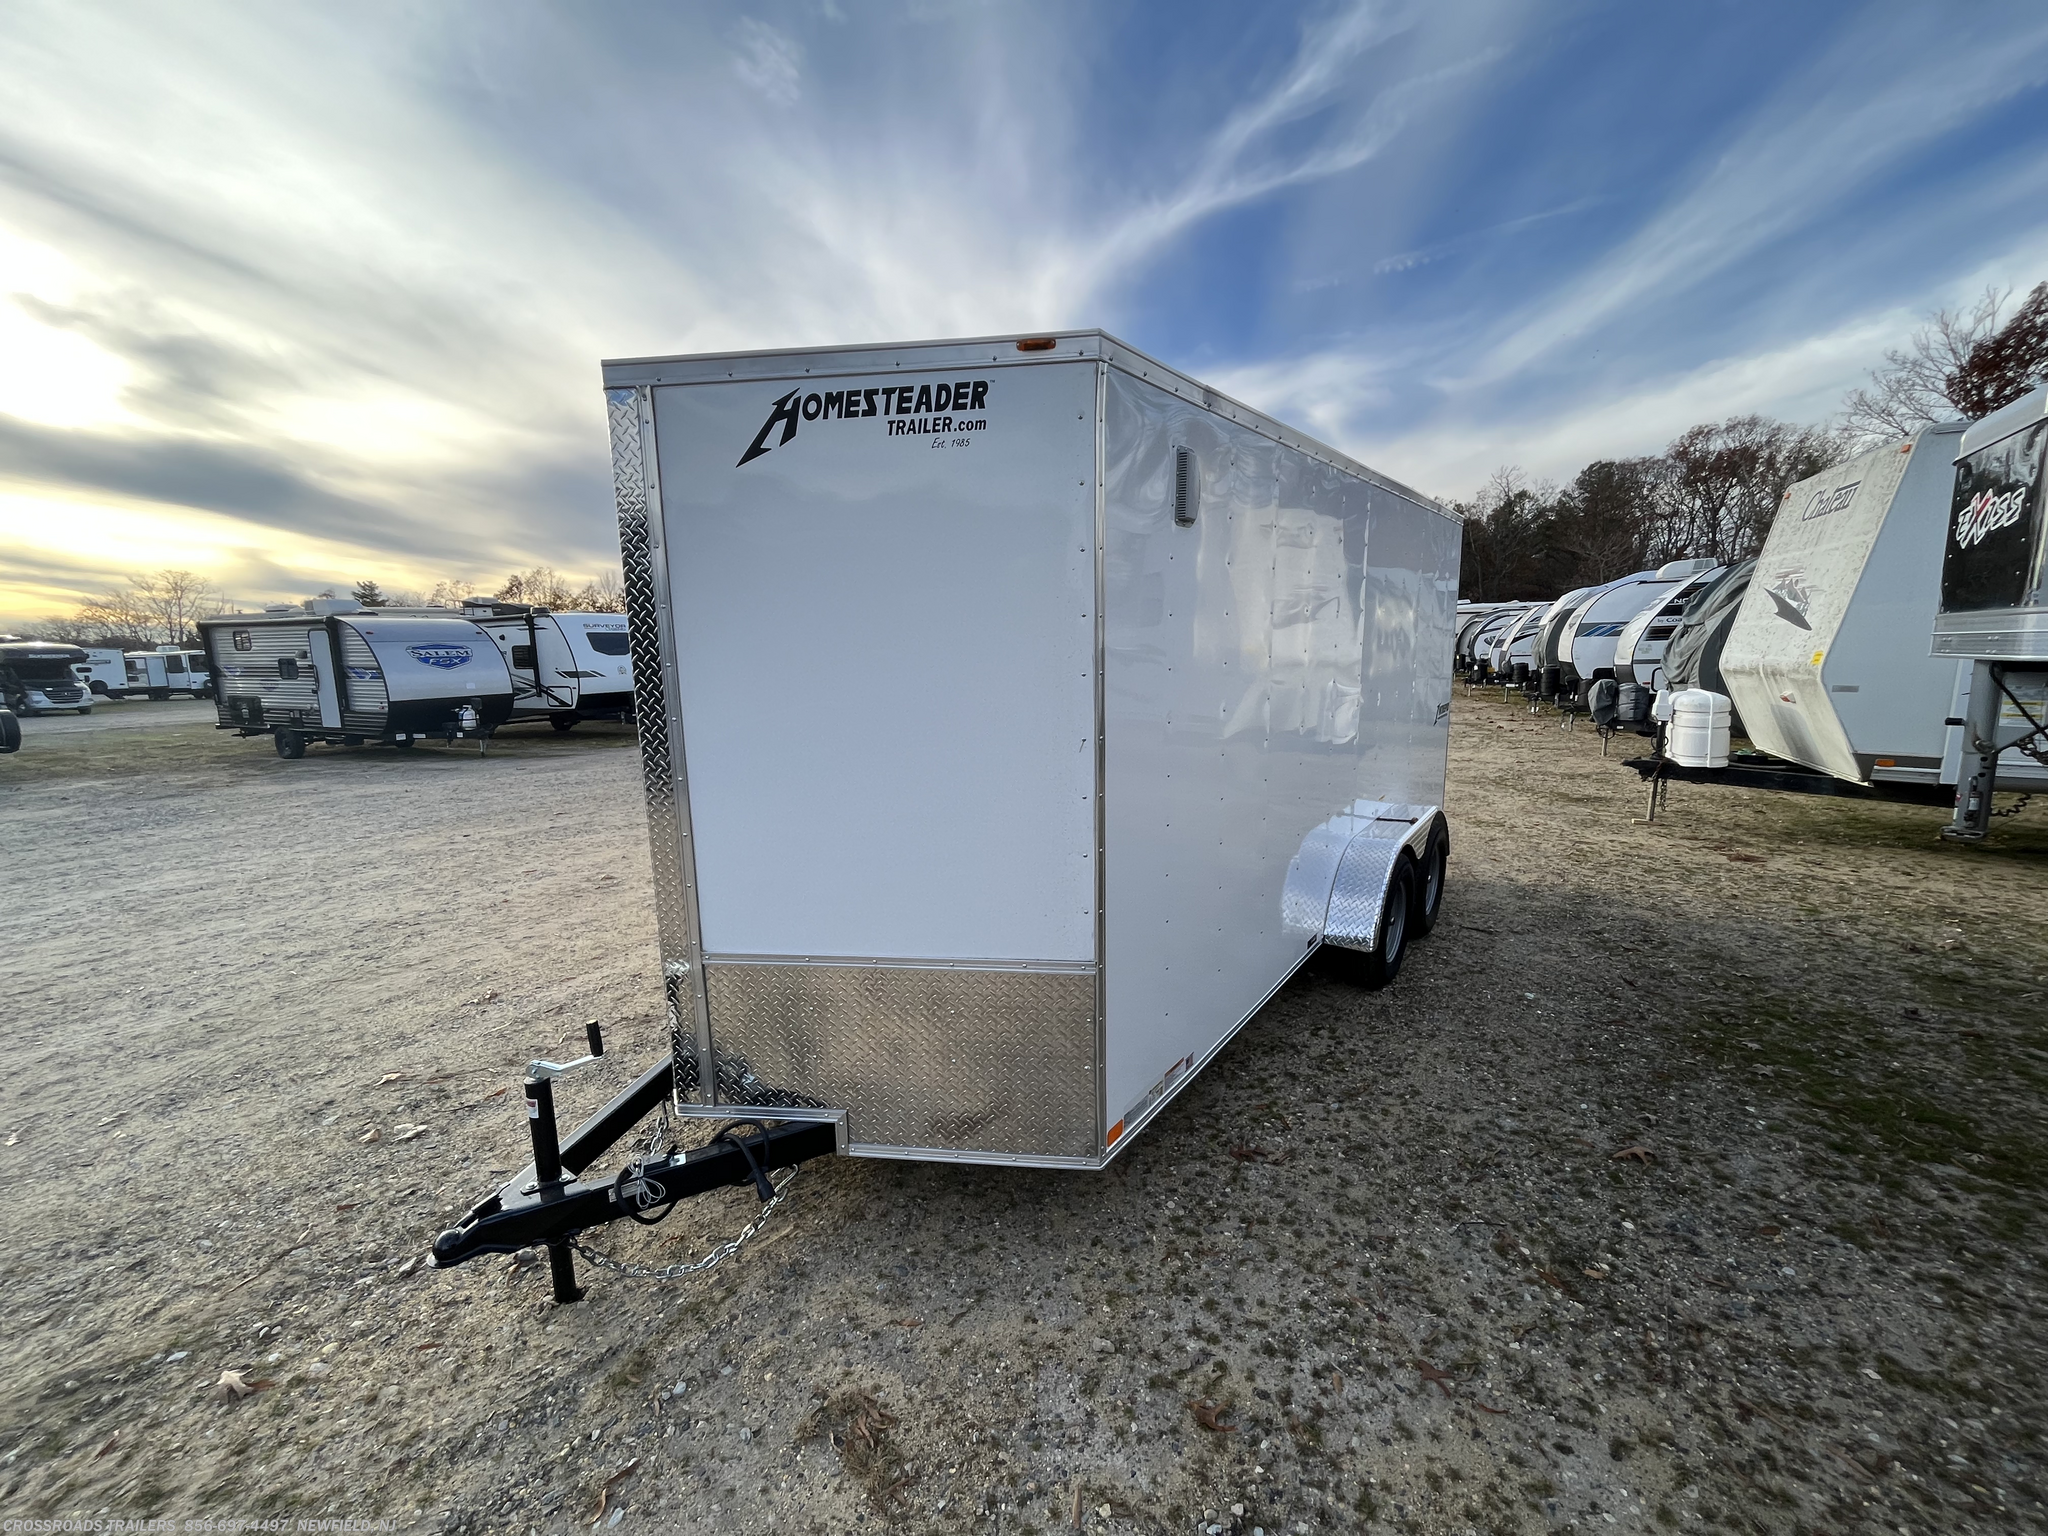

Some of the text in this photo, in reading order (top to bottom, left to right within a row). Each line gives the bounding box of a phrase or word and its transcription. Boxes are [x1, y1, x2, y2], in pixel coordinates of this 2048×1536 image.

[735, 380, 989, 468] HOMESTEADER
[931, 437, 971, 449] Est. 1985
[1802, 480, 1862, 521] Chateau
[410, 649, 471, 657] SALEM
